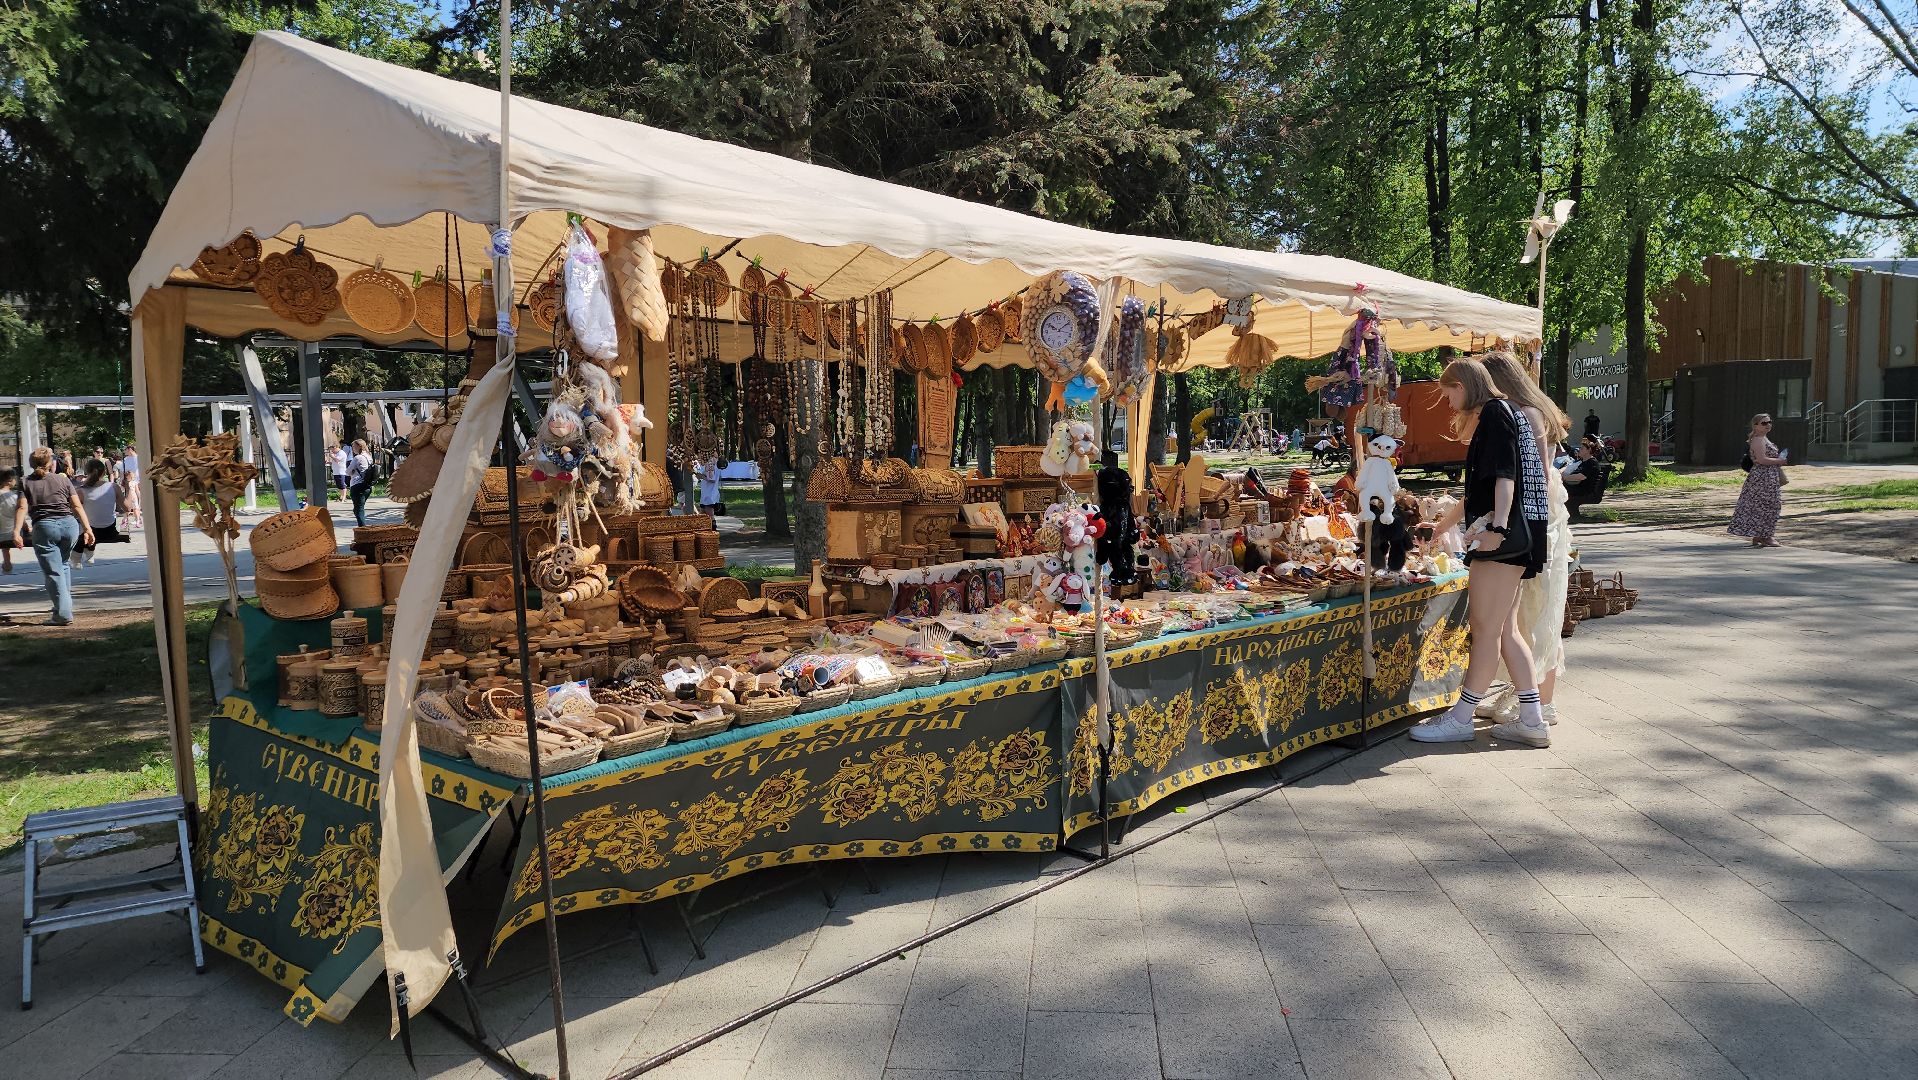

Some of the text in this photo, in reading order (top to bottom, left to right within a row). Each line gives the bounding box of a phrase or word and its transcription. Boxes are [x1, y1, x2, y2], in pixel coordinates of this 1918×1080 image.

[1582, 384, 1619, 400] ПРОКАТ
[1212, 628, 1327, 666] НАРОДНЫЕ
[711, 711, 969, 780] СУВЕНИРЫ
